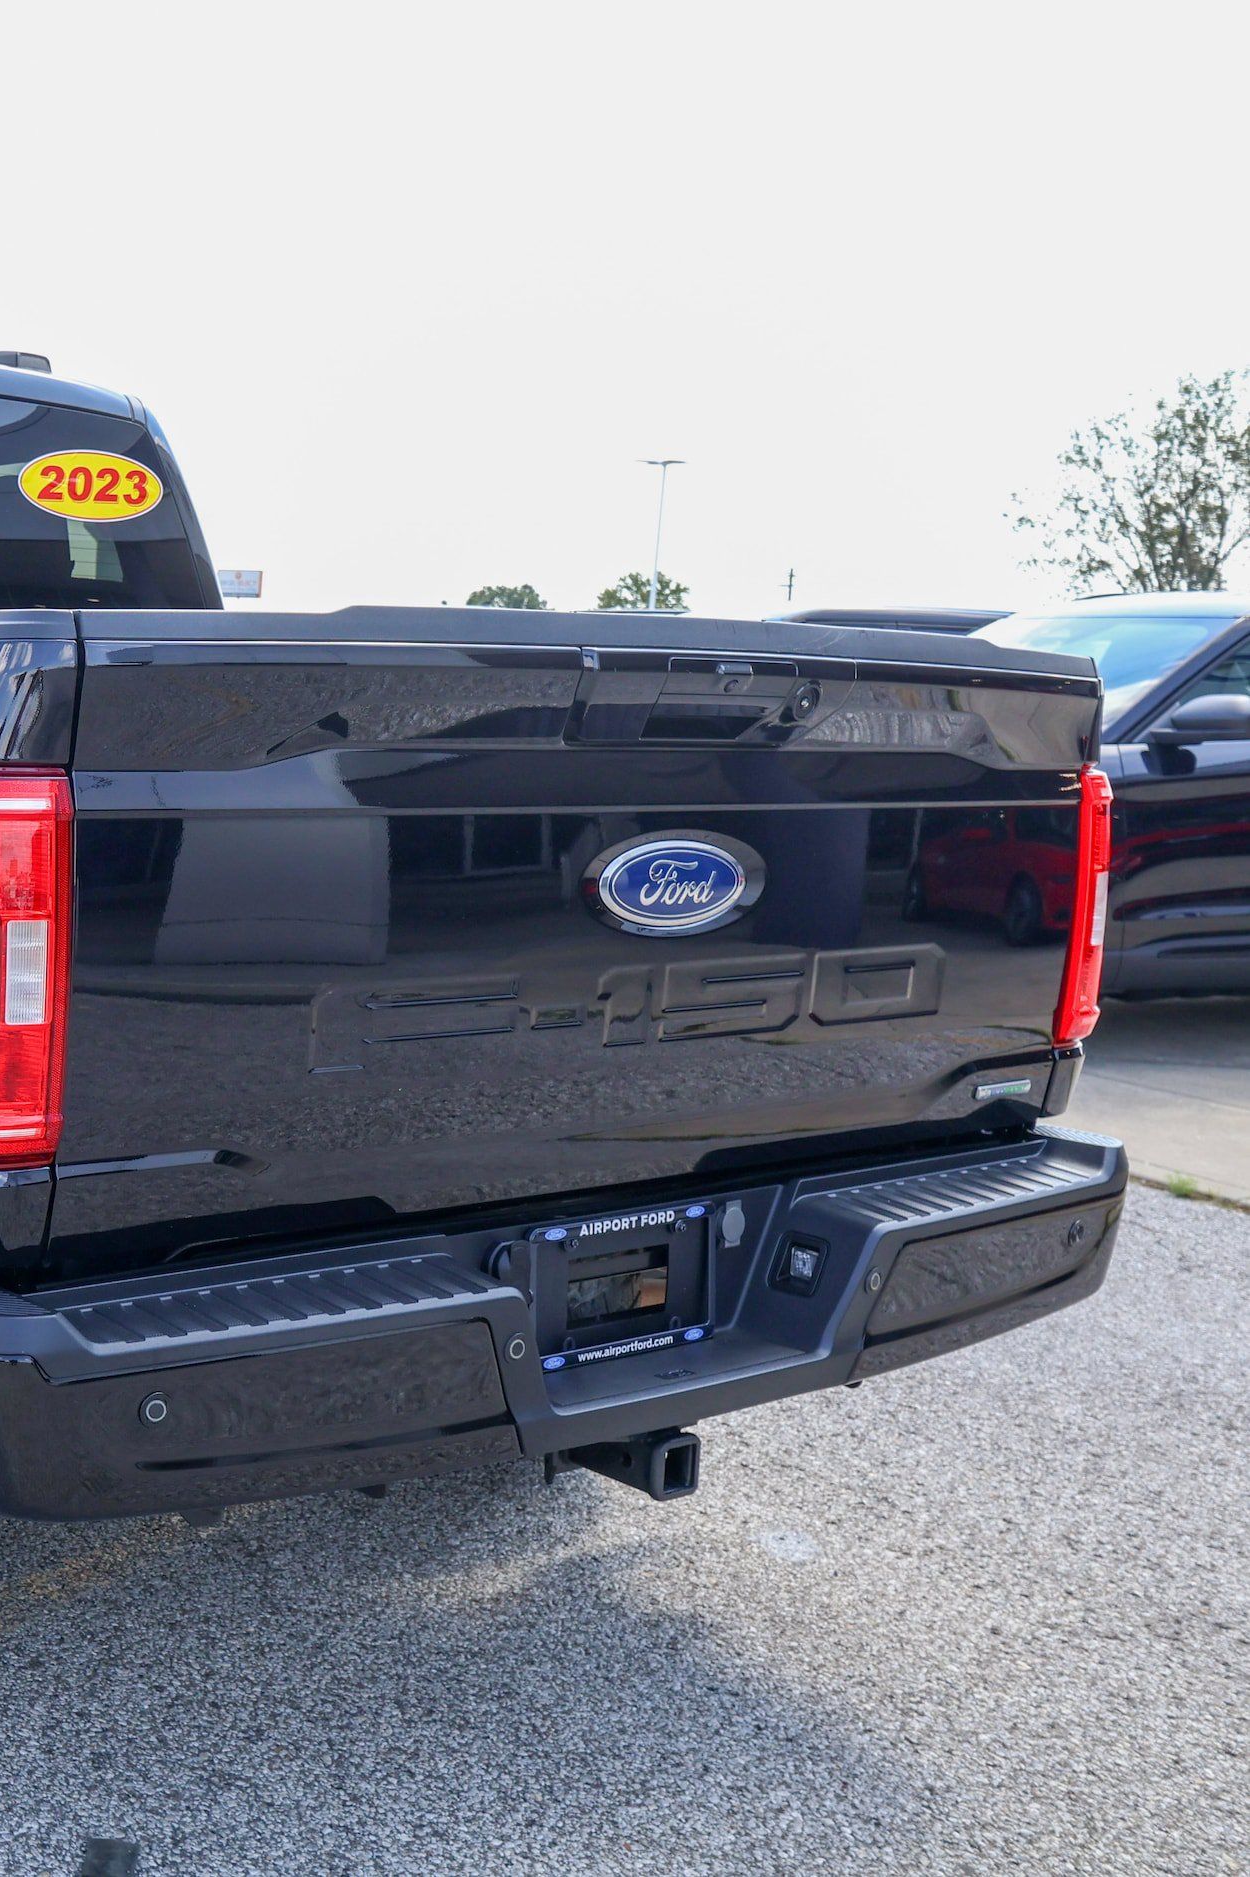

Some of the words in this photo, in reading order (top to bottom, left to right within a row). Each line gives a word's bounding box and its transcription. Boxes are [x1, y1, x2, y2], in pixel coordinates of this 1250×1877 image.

[37, 465, 149, 507] 2023
[639, 859, 717, 907] Ford
[307, 943, 947, 1075] F-150
[579, 1216, 639, 1237] AIRPORT
[640, 1210, 676, 1227] FORD
[577, 1335, 674, 1362] www.airportford.com
